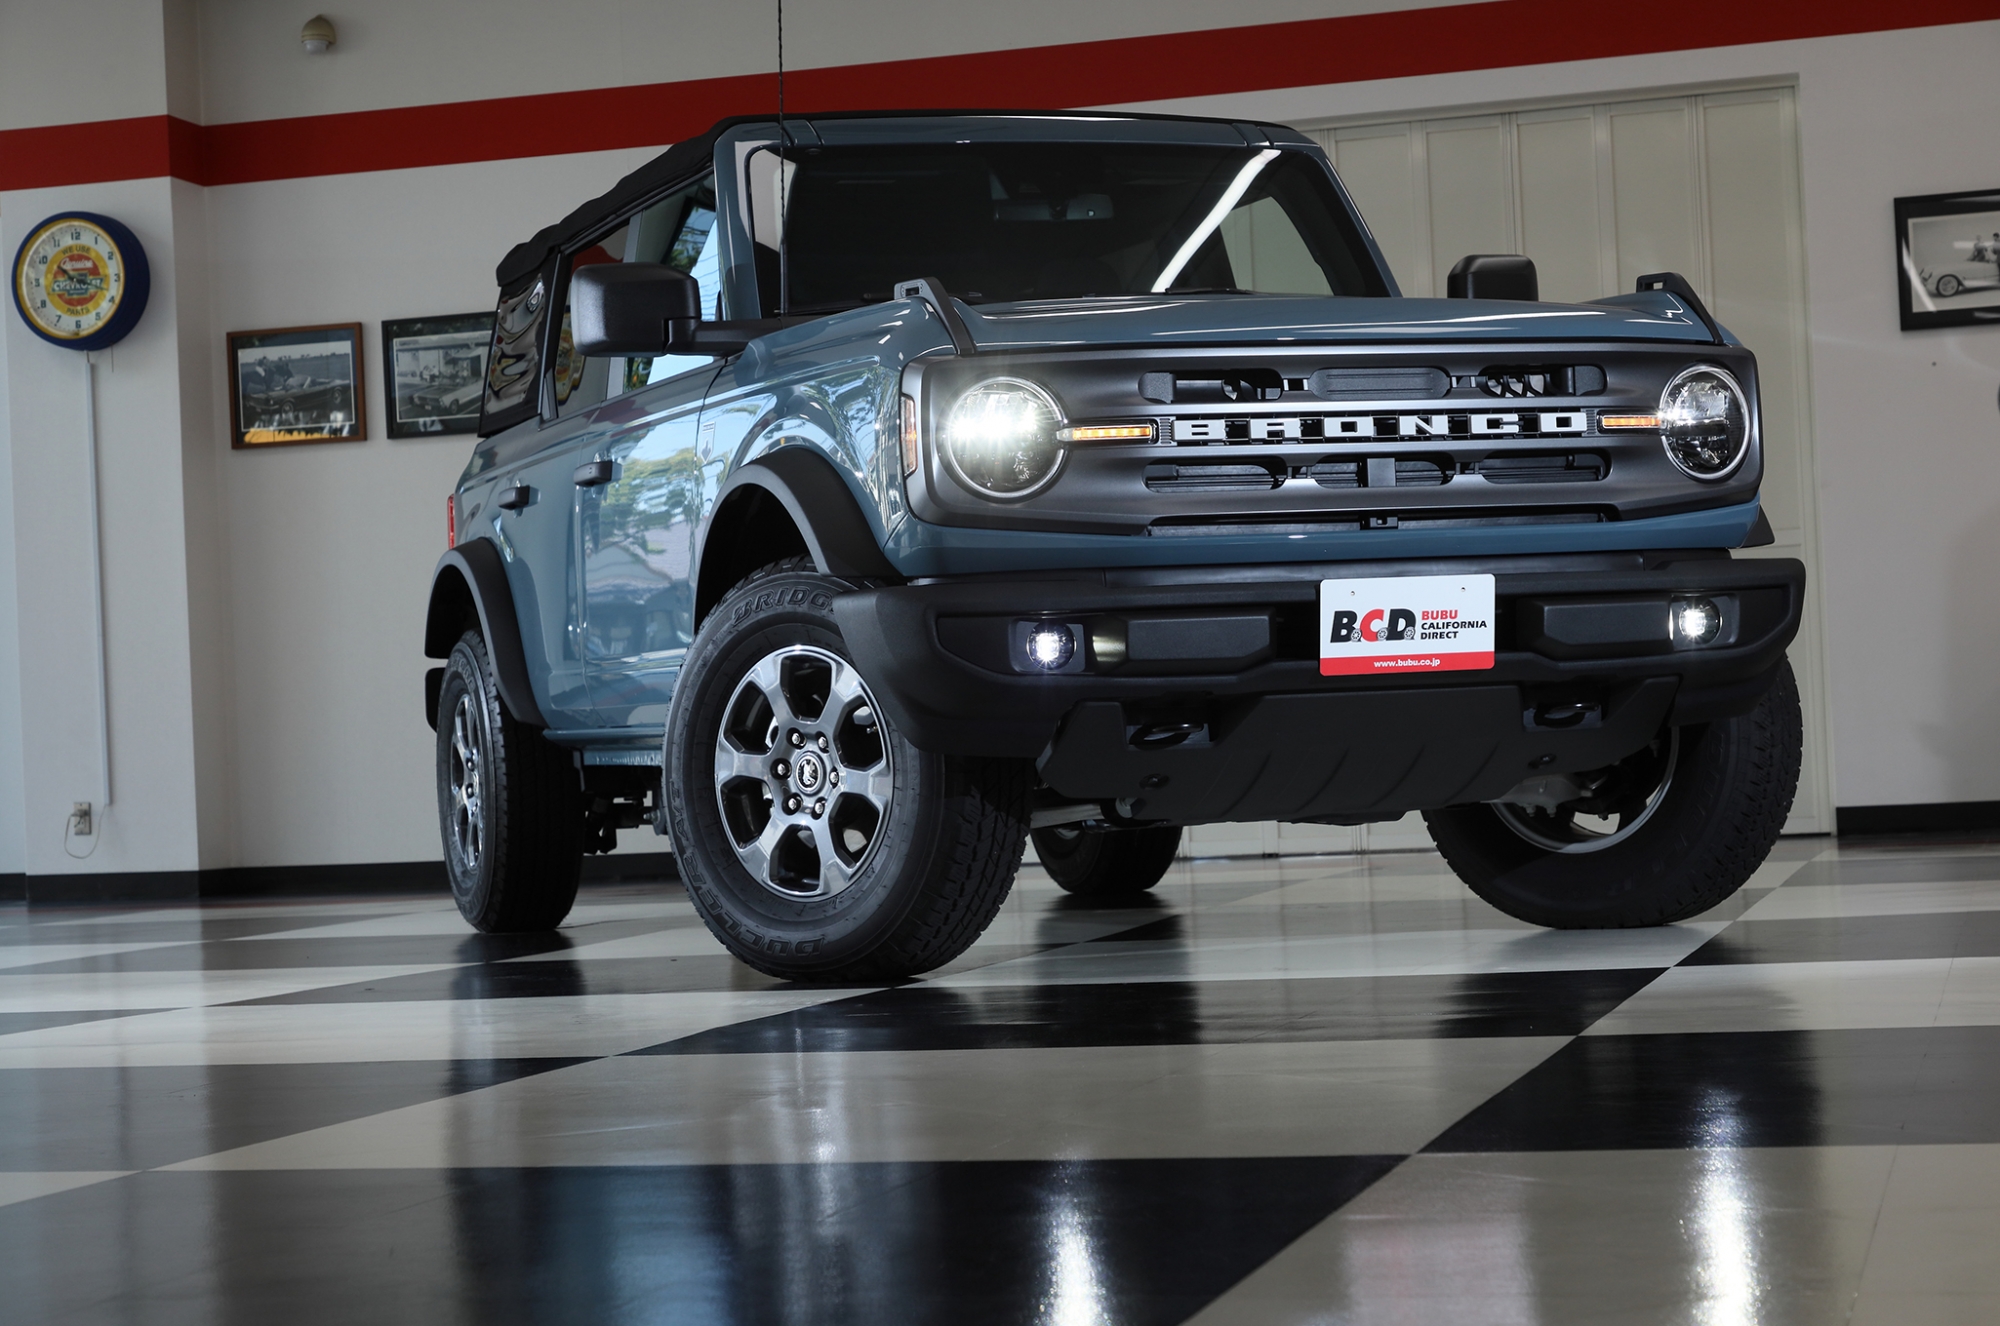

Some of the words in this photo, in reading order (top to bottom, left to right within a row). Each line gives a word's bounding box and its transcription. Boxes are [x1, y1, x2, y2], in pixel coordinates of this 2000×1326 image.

[71, 231, 81, 241] 12
[53, 238, 60, 248] 11
[62, 246, 73, 255] WE
[75, 244, 91, 254] USE
[38, 255, 48, 264] 10
[107, 251, 114, 260] 2
[114, 273, 120, 282] 3
[34, 278, 40, 287] 9
[40, 299, 47, 308] 8
[108, 295, 115, 304] 4
[66, 306, 90, 316] PARTS
[55, 315, 62, 324] 7
[95, 312, 101, 321] 5
[75, 320, 81, 329] 6
[1171, 412, 1587, 442] BRONCO
[731, 585, 834, 628] BRIDG
[1421, 609, 1459, 621] BUBU
[1421, 620, 1488, 630] CALIFORNIA
[1420, 631, 1459, 640] DIRECT
[1374, 658, 1441, 668] www.bubu.co.jp
